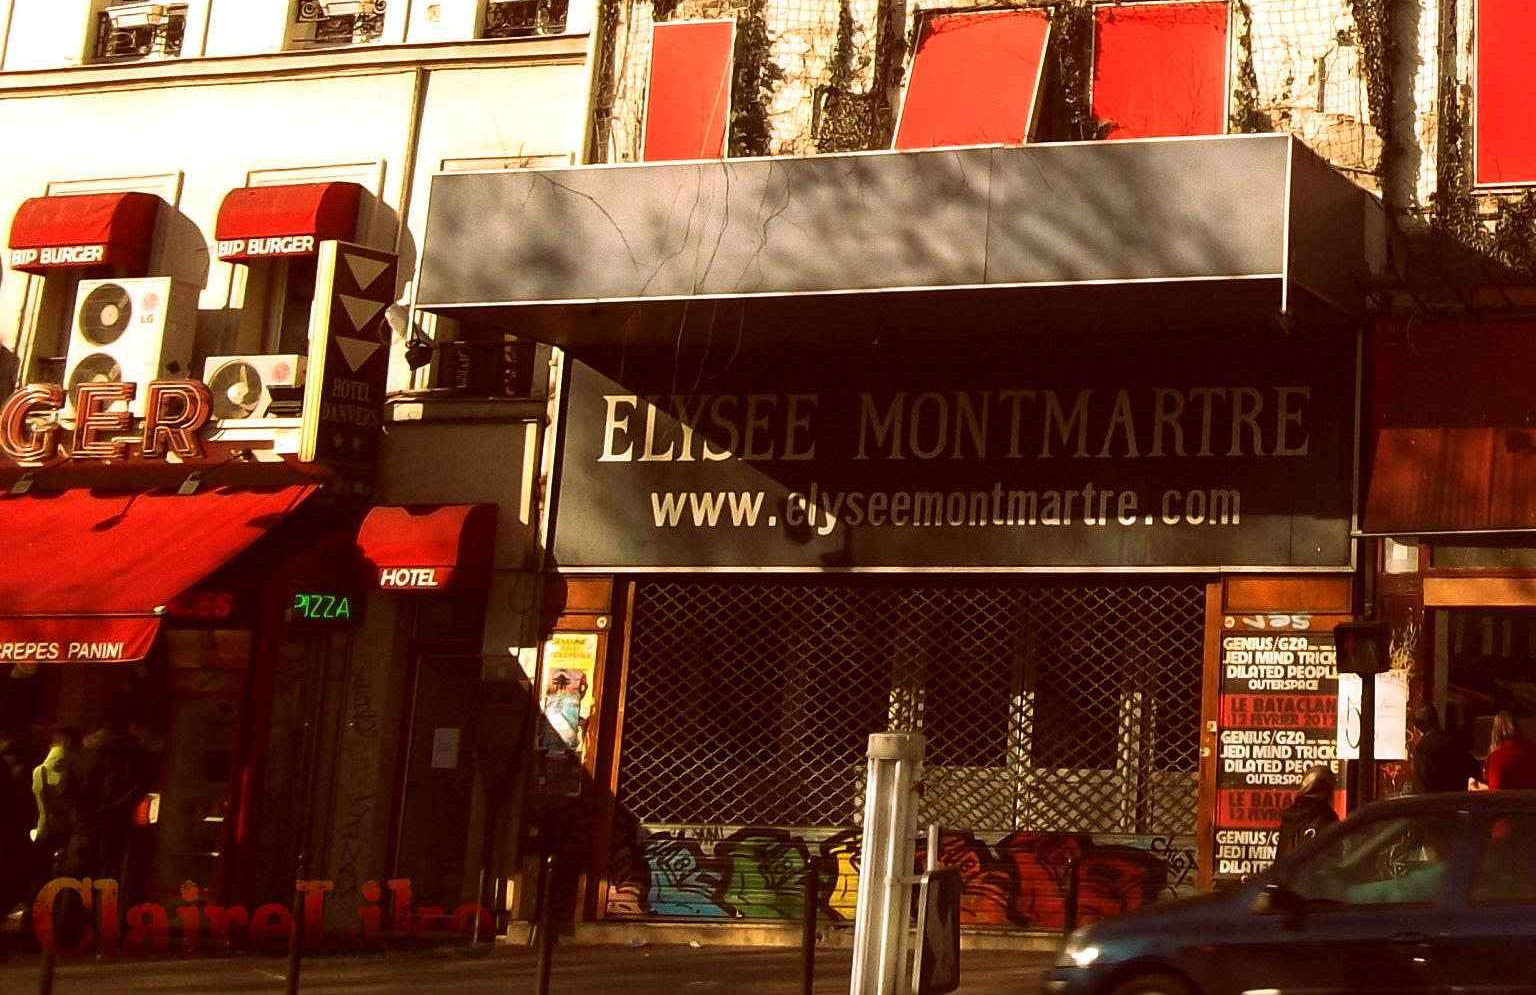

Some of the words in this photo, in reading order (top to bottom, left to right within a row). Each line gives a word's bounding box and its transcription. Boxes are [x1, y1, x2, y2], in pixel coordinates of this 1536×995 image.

[218, 239, 245, 257] BIP
[247, 235, 314, 255] BURGER
[11, 249, 37, 266] BIP
[40, 245, 103, 264] BURGER
[140, 314, 154, 324] LG
[597, 394, 818, 463] ELYSEE
[853, 386, 1311, 463] MONTMARTRE
[650, 480, 1241, 537] www.elyseemontmartre.com
[381, 569, 438, 586] HOTEL
[294, 594, 349, 618] PIZZA
[0, 642, 59, 660] REPES
[68, 642, 124, 659] PANINI
[1223, 636, 1308, 652] GENIUS/GZA
[1222, 651, 1253, 664] JEDI
[1255, 651, 1295, 664] MIND
[1297, 651, 1337, 664] TRICK
[1227, 665, 1285, 679] DILATED
[1248, 679, 1319, 690] OUTERSPACE
[1231, 697, 1248, 712] LE
[1254, 697, 1337, 713] BATACLAN
[1231, 713, 1246, 726] 12
[1220, 730, 1305, 745] GENIUS/GZA
[1220, 746, 1250, 759] JEDI
[1252, 746, 1292, 759] MIND
[1295, 746, 1338, 759] TRICK
[1224, 759, 1282, 773] DILATED
[1285, 759, 1339, 774] PEOE
[1246, 774, 1303, 784] OUTERSPA
[1228, 791, 1245, 807] LE
[1251, 791, 1295, 808] BATA
[1216, 830, 1280, 846] GENIUS/G
[1216, 845, 1246, 859] JEDI
[1248, 845, 1278, 860] MIN
[1219, 860, 1274, 873] DILATE
